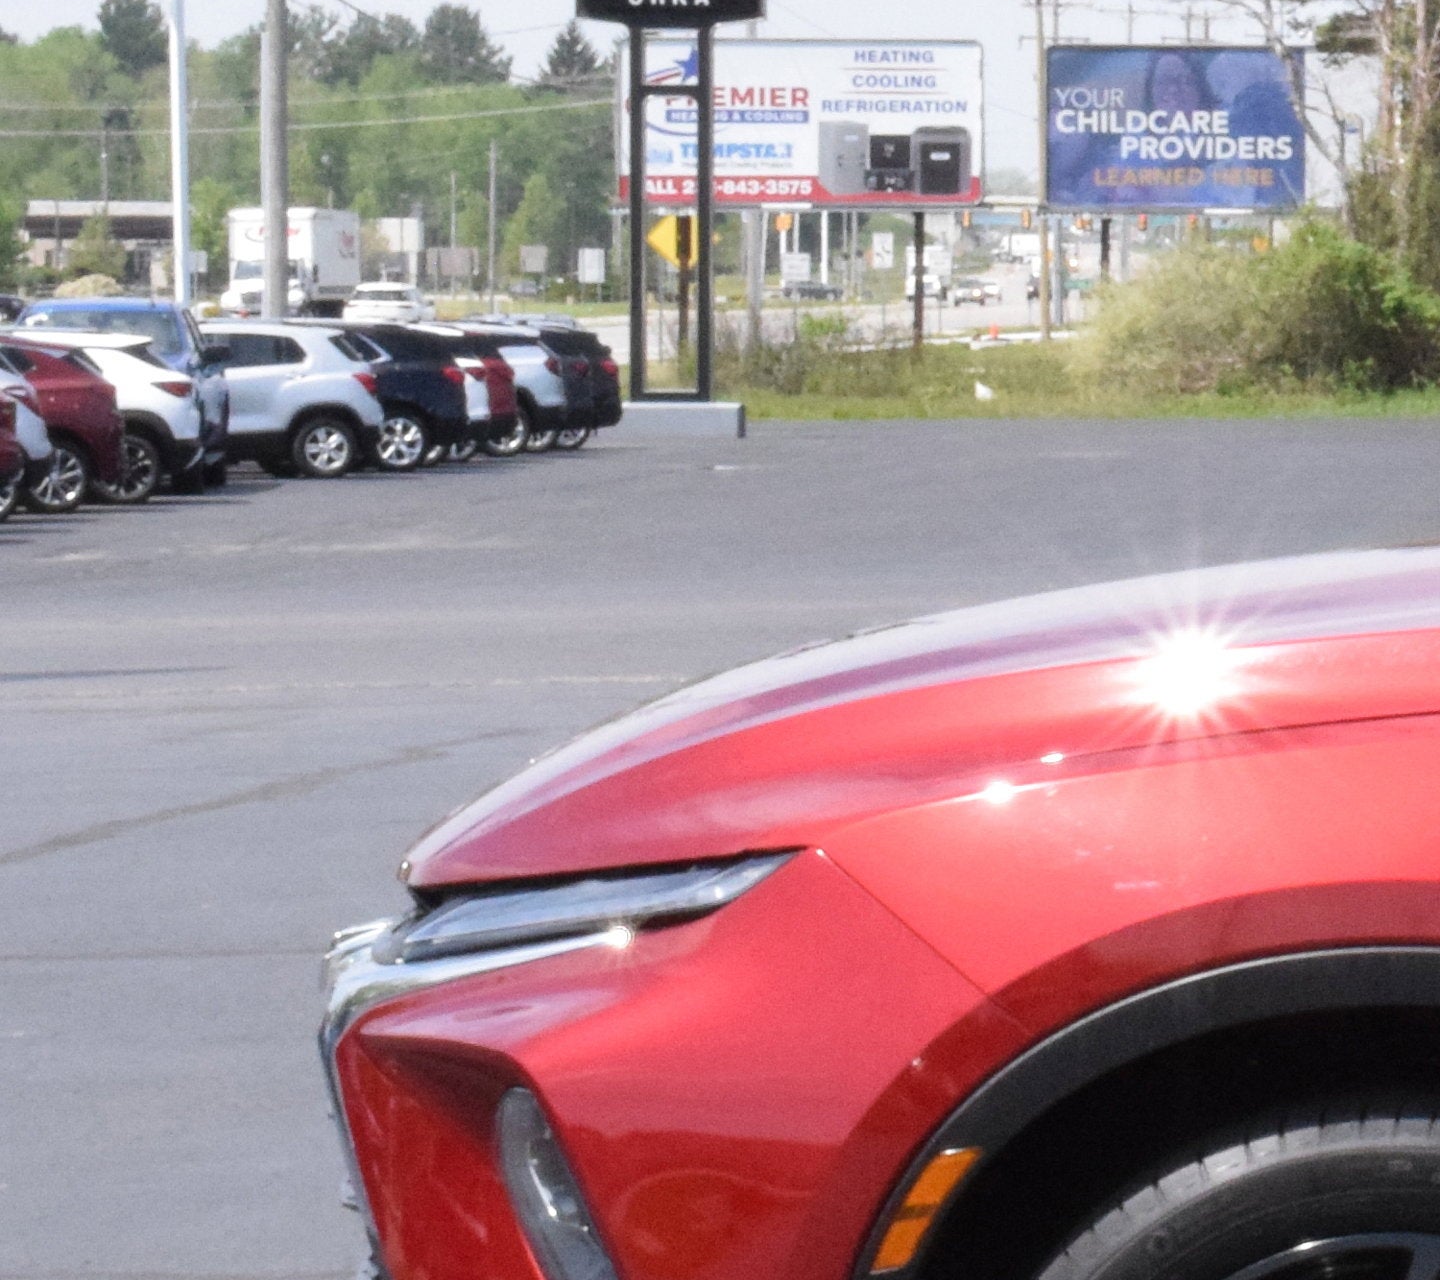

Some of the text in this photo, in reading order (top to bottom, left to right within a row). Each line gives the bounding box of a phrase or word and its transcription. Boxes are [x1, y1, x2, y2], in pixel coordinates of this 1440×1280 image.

[854, 49, 935, 64] HEATING
[852, 74, 937, 89] COOLING
[666, 87, 809, 107] EMIER
[1055, 87, 1125, 108] YOUR
[821, 100, 968, 114] REFRIGERATION
[1055, 110, 1229, 134] CHILDCARE
[680, 143, 793, 158] TMPSTA
[1120, 136, 1293, 160] PROVIDERS
[1094, 168, 1275, 186] LEARNED HERE
[641, 180, 812, 195] ALL 2-843-3575
